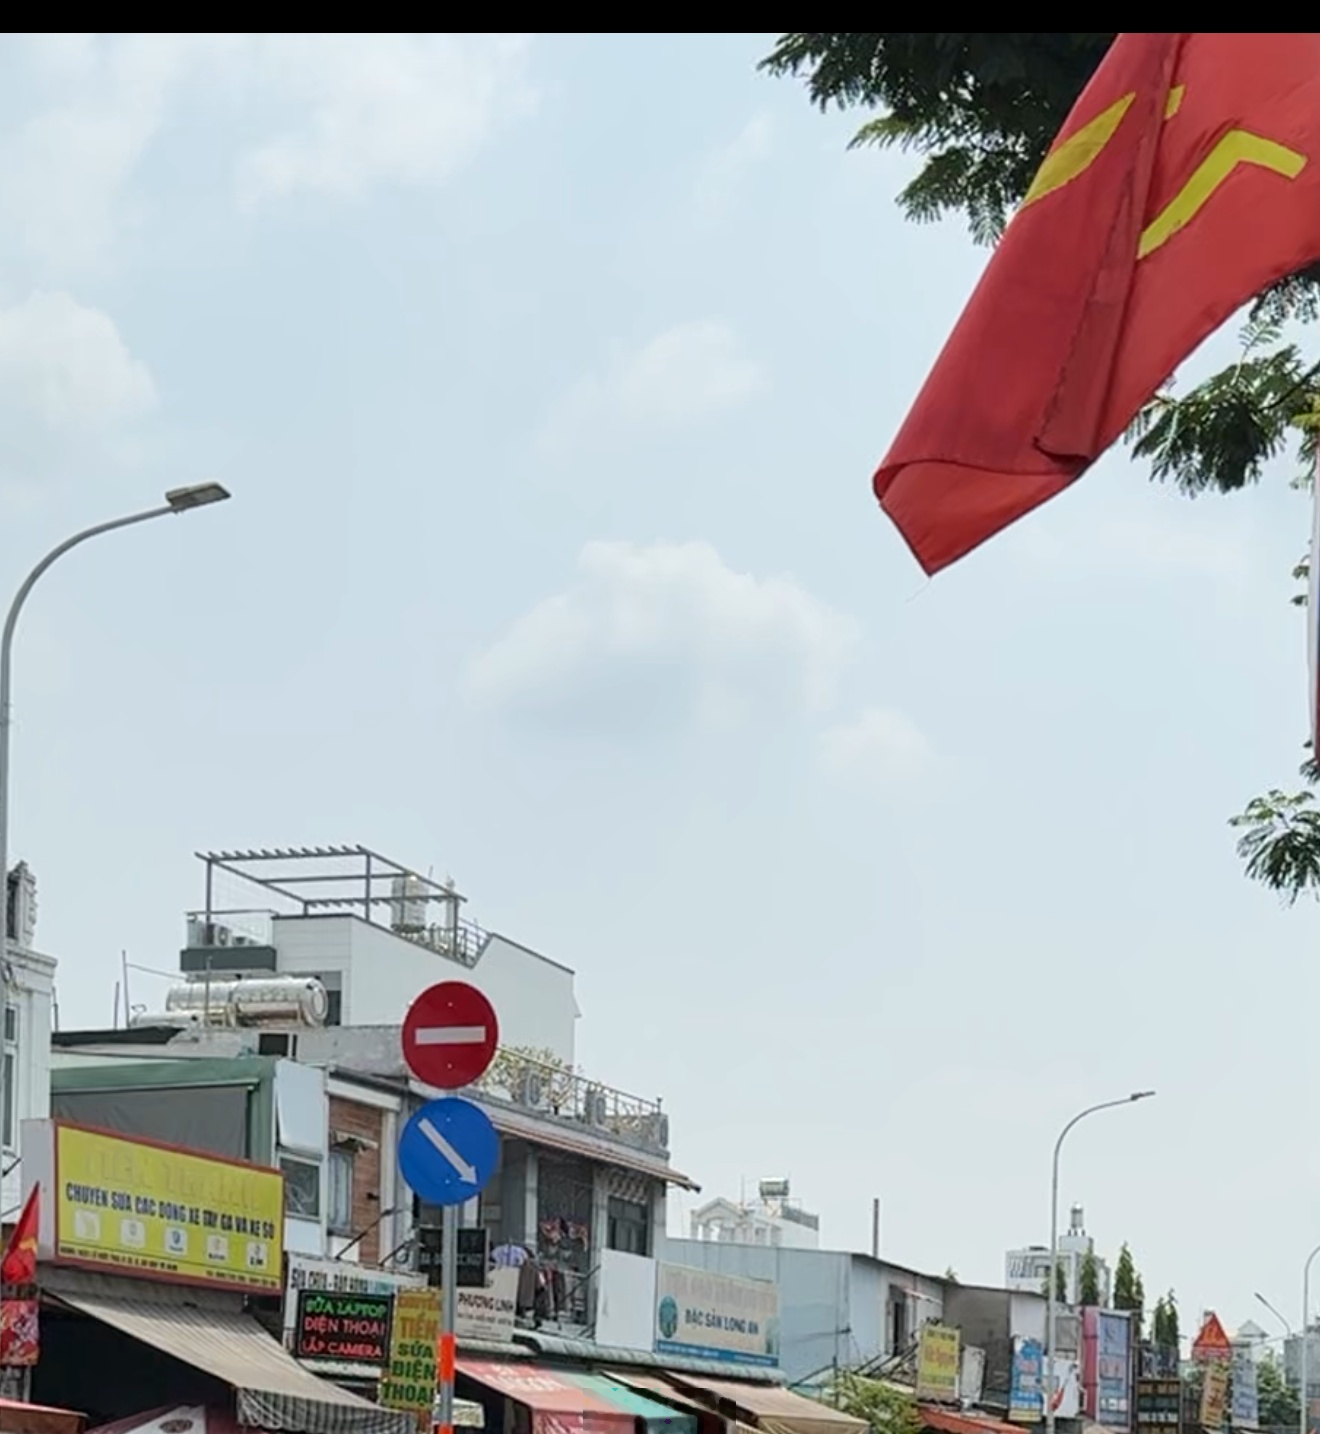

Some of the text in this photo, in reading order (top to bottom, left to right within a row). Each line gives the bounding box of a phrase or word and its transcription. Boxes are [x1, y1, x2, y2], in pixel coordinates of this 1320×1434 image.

[337, 1301, 387, 1317] LAPTOP
[304, 1315, 386, 1338] ĐIỆN THOẠI
[327, 1342, 383, 1357] CAMERA
